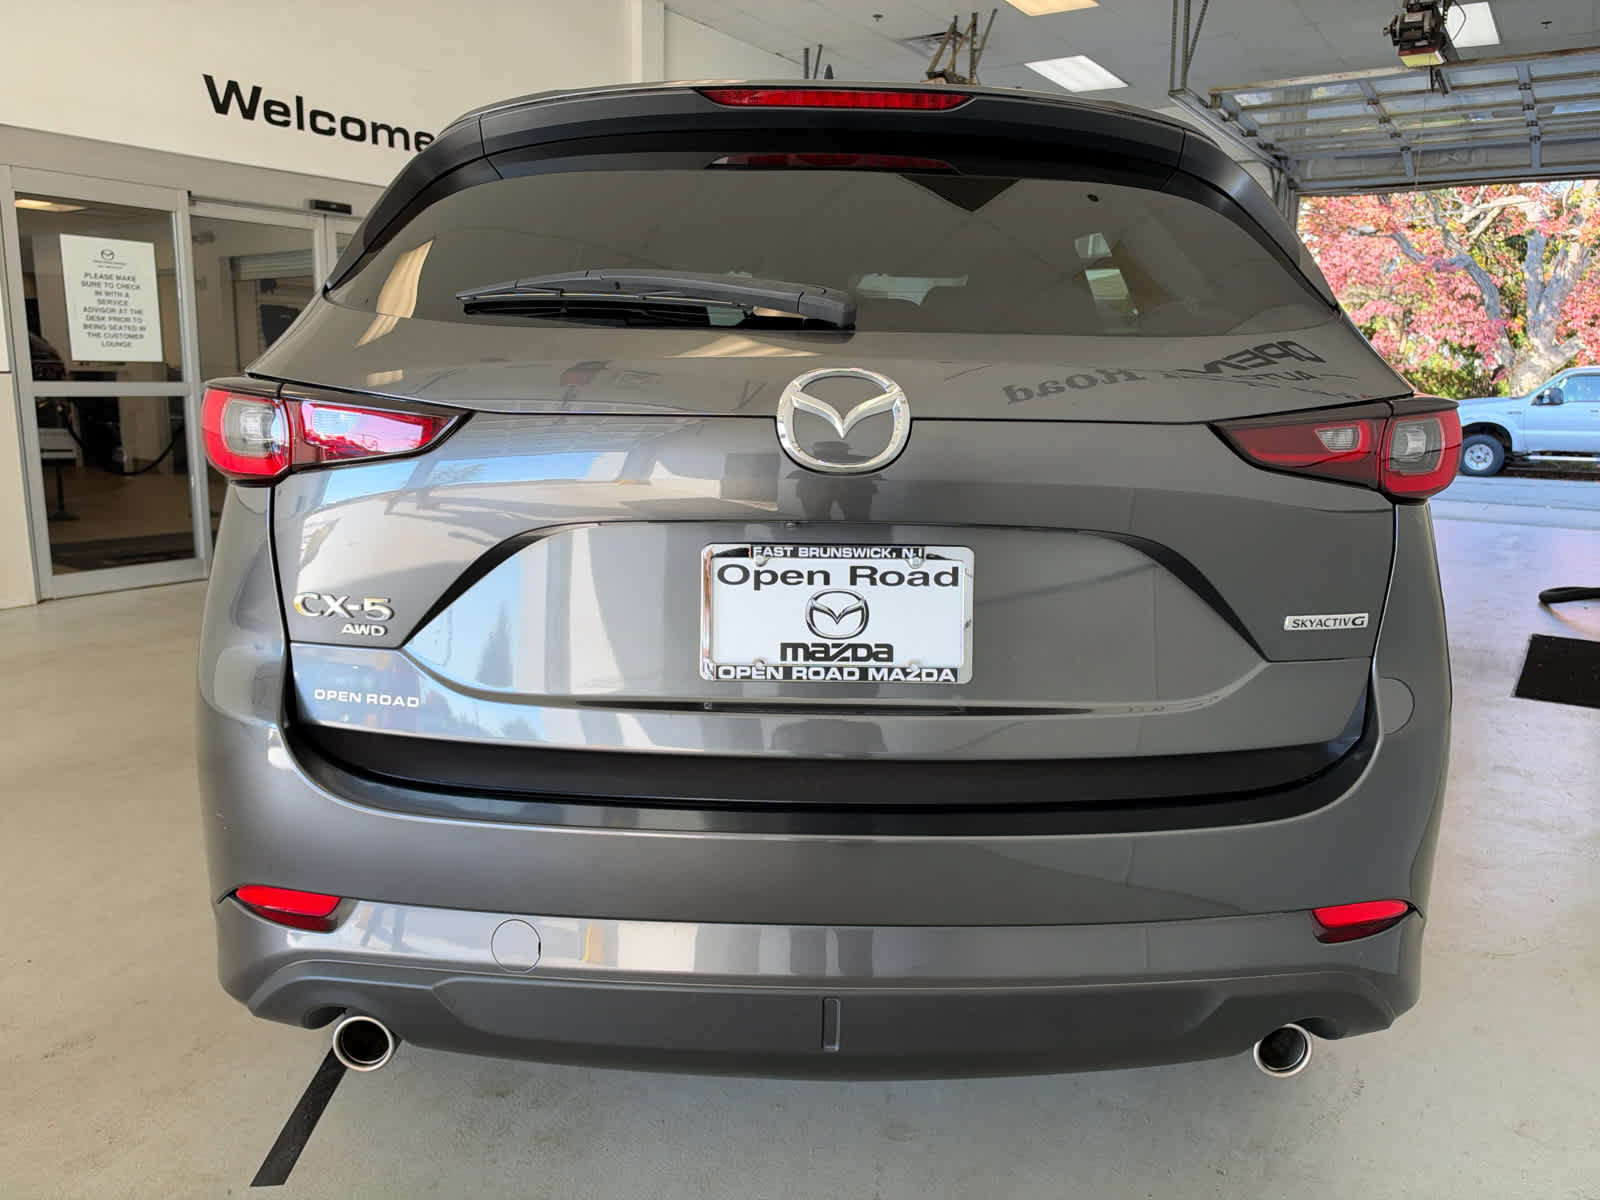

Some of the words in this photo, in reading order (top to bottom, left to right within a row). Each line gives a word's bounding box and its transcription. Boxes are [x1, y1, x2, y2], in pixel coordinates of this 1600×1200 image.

[202, 74, 435, 152] Welcome
[84, 272, 113, 281] PLEASE
[81, 280, 101, 288] SURE
[116, 282, 140, 290] CHECK
[97, 298, 128, 306] SERVICE
[83, 306, 116, 314] ADVISOR
[108, 324, 137, 332] SEATED
[87, 331, 102, 339] THE
[103, 332, 144, 340] CUSTOMER
[101, 340, 132, 348] LOUNGE
[798, 547, 896, 559] BRUNSWICK,
[717, 563, 831, 591] Open
[849, 565, 959, 587] Road
[294, 592, 394, 621] CX-5
[342, 624, 387, 636] AWD
[780, 642, 893, 662] mazda
[718, 666, 783, 680] OPEN
[791, 667, 860, 681] ROAD
[868, 667, 956, 682] MAZDA
[314, 689, 362, 703] OPEN
[366, 693, 419, 707] ROAD
